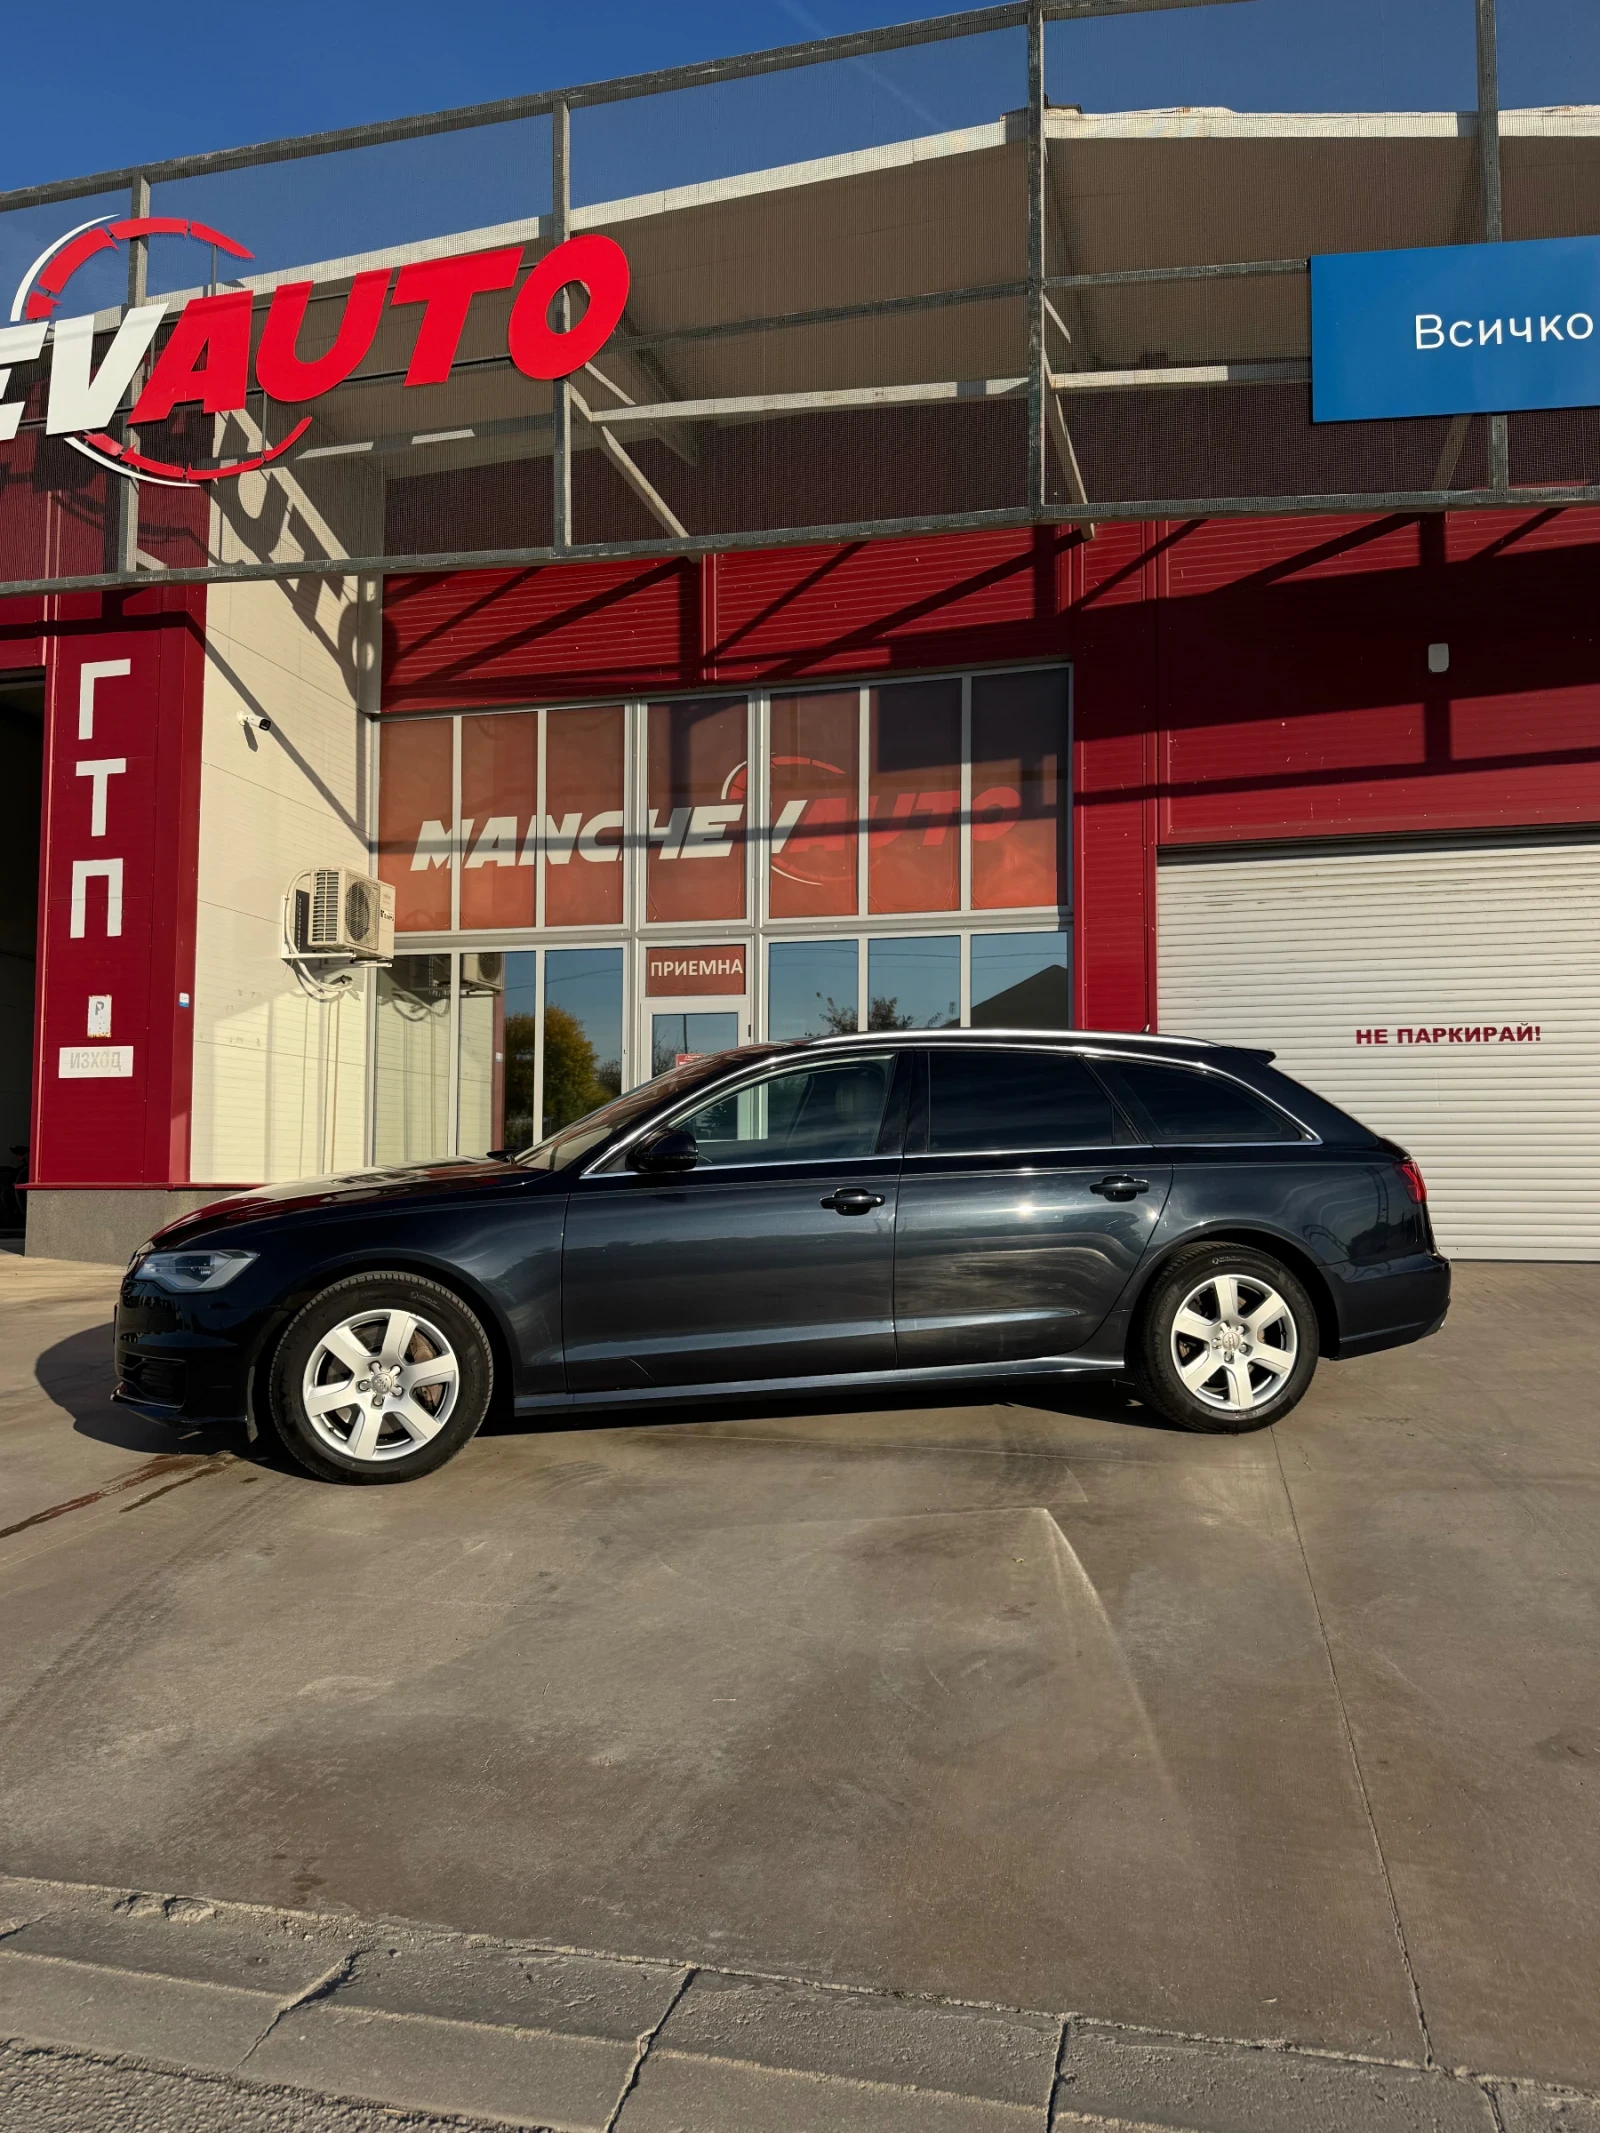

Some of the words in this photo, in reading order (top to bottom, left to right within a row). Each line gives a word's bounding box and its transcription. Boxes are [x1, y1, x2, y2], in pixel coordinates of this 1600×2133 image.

[1414, 312, 1594, 350] Всичко
[651, 959, 744, 976] ПРИЕМНА
[1356, 1029, 1388, 1044] НЕ
[1397, 1022, 1541, 1043] ПАРКИРАЙ!
[69, 1052, 121, 1071] ИЗХОД
